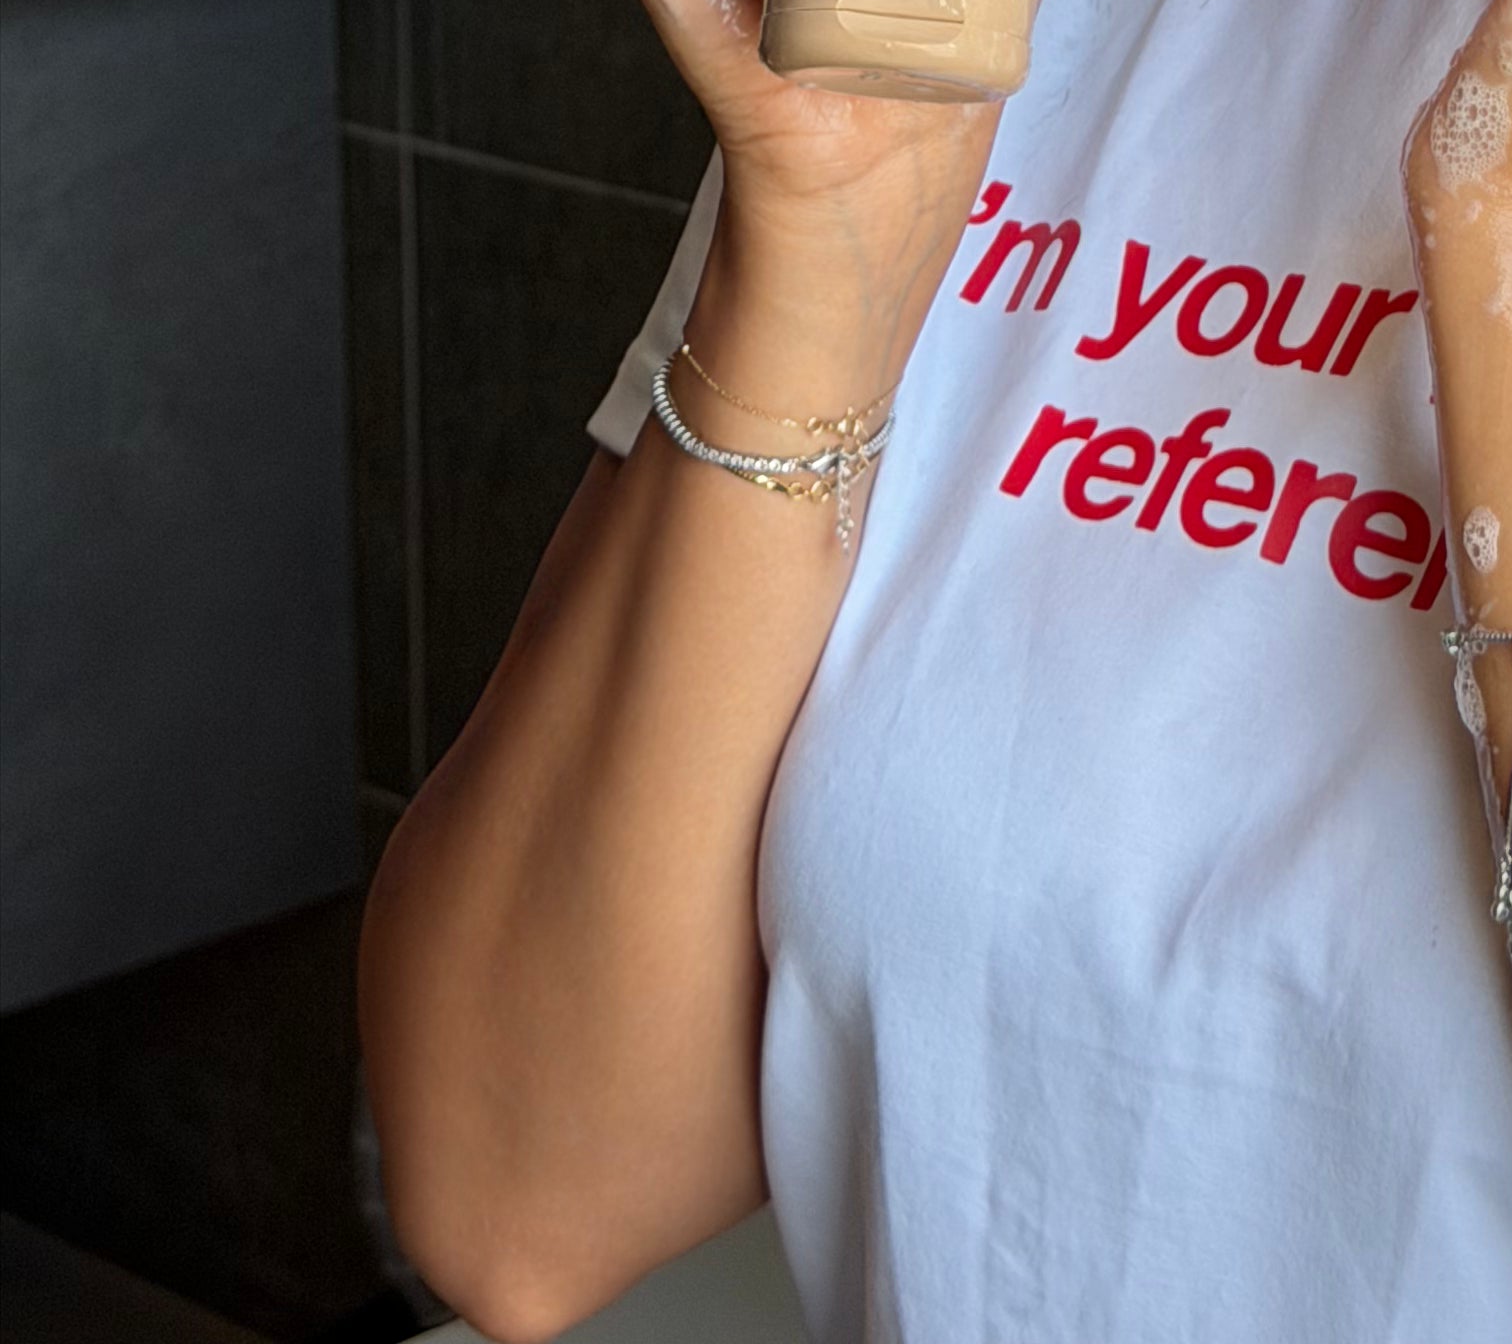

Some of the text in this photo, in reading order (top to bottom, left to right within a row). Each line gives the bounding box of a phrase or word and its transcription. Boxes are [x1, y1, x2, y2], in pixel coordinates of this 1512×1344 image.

[959, 180, 1082, 313] 'm
[1074, 239, 1420, 376] your
[999, 404, 1448, 612] refere
